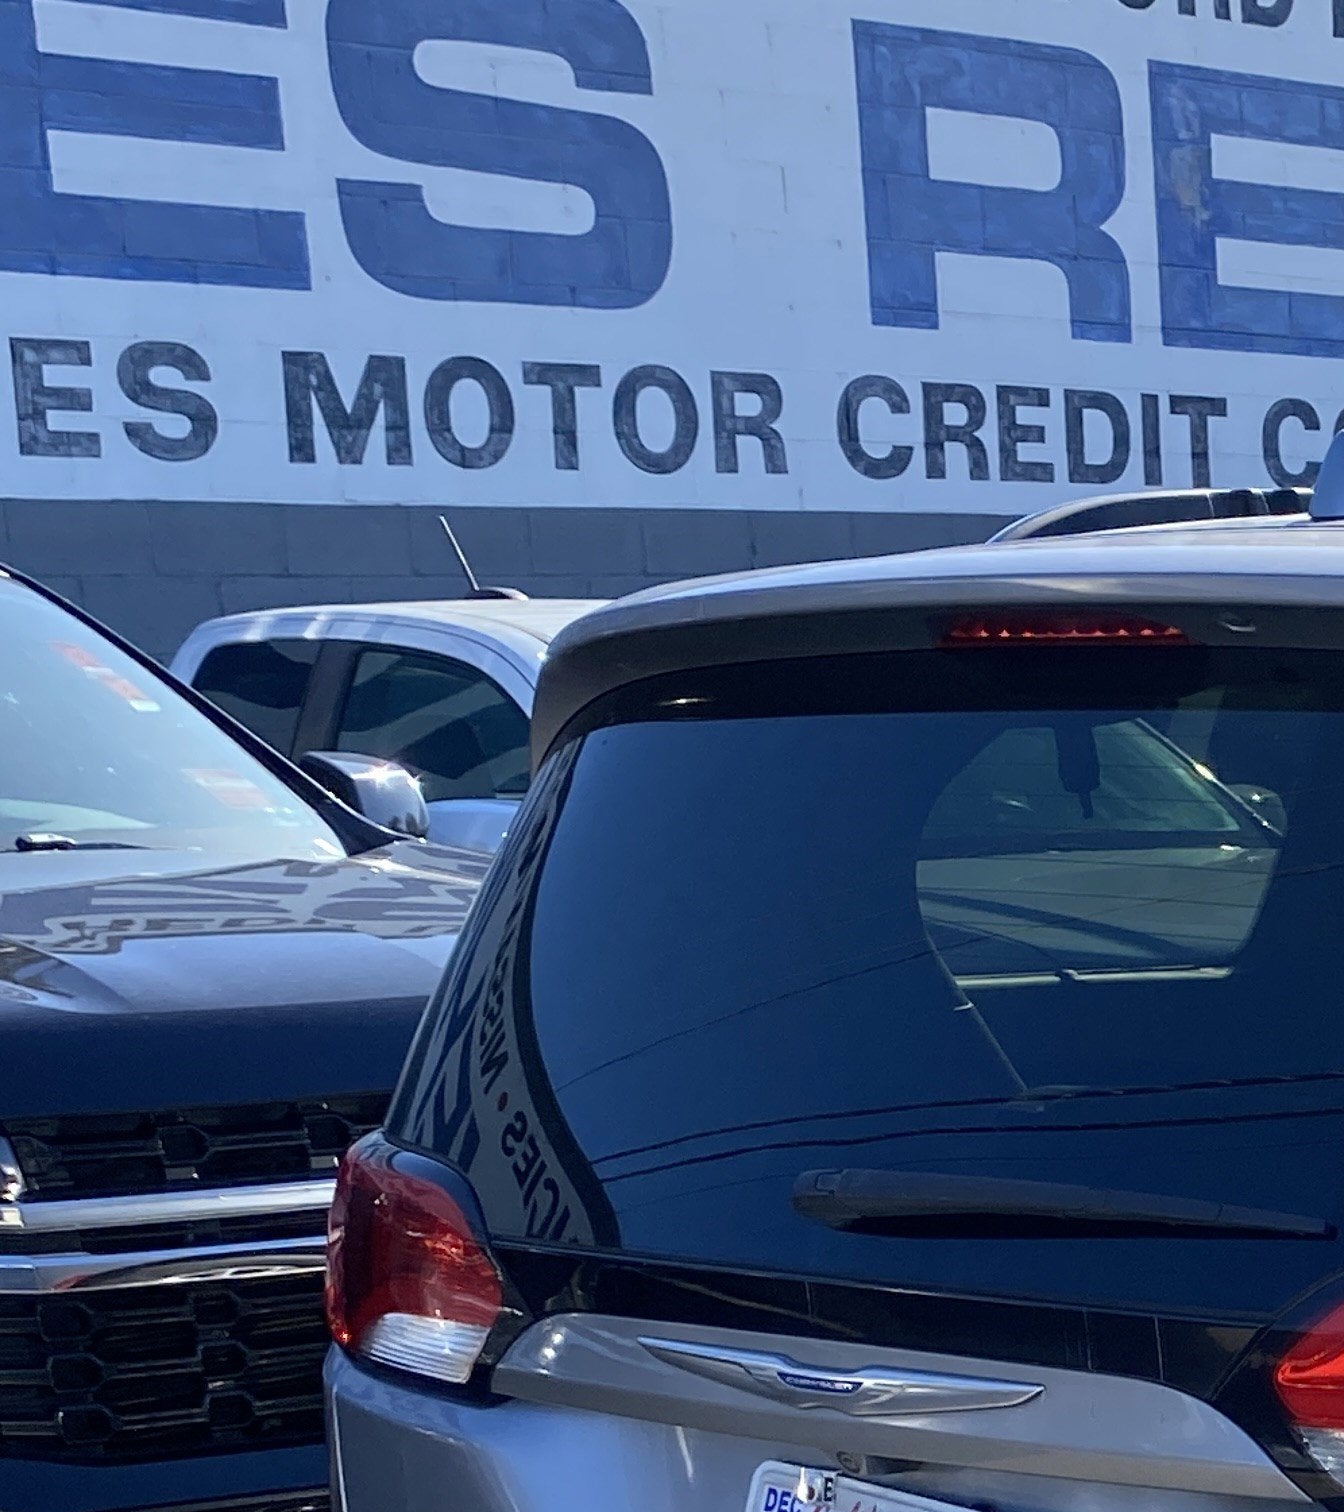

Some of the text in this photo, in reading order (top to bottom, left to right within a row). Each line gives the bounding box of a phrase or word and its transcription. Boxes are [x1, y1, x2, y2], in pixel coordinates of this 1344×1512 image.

[8, 337, 218, 462] ES
[281, 350, 788, 475] MOTOR
[836, 374, 1228, 489] CREDIT
